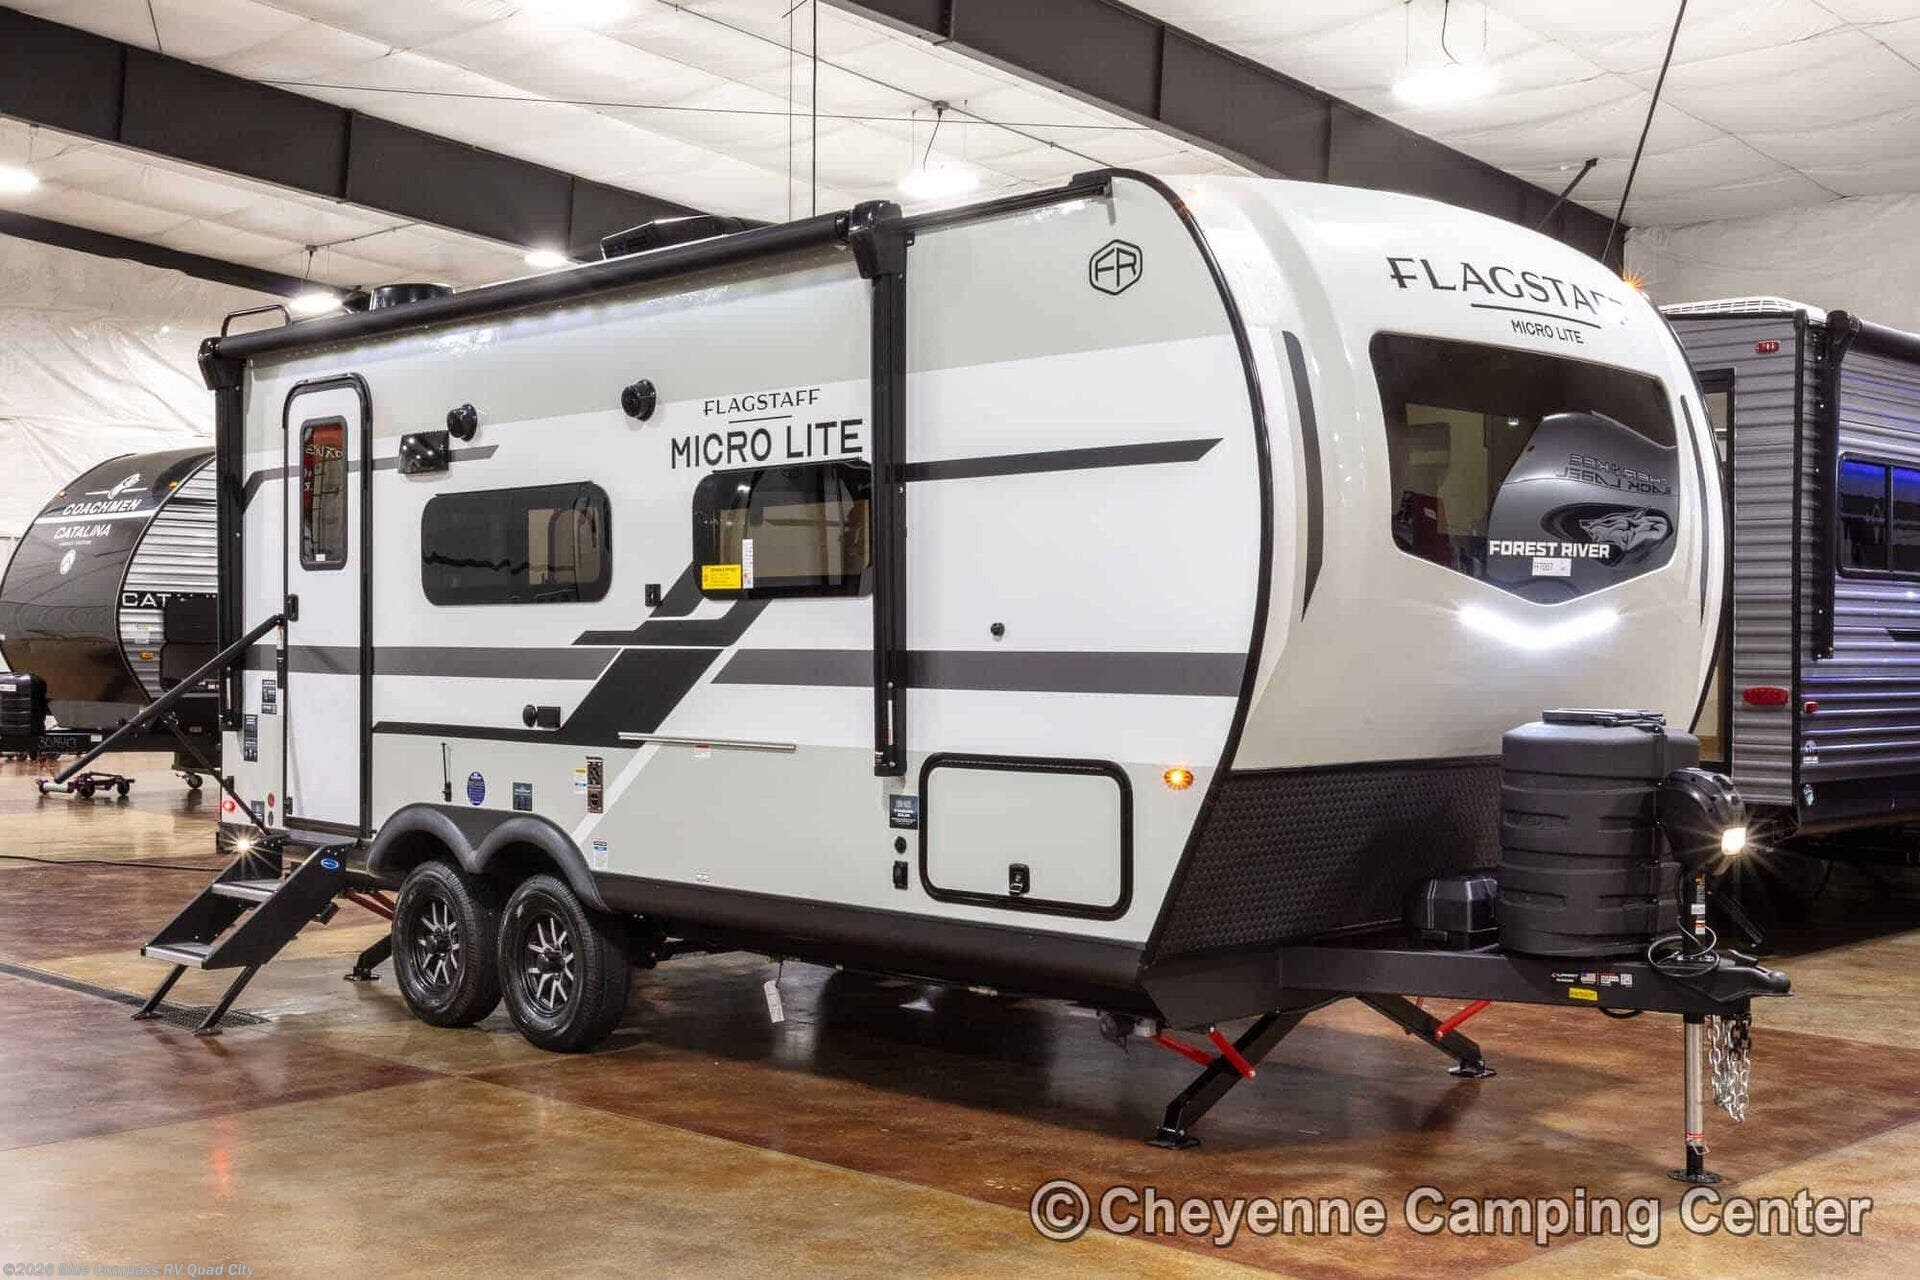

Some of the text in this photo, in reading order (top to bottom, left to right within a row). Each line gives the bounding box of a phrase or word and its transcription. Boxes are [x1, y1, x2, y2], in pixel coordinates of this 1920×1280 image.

[1386, 256, 1628, 325] FLAGSTA
[1510, 319, 1585, 344] MICRO LITE
[702, 388, 821, 416] FLAGSTAFF
[671, 418, 864, 470] MICRO LITE
[62, 498, 143, 516] COACHMEN
[54, 523, 112, 540] CATALINA
[1489, 540, 1611, 559] FOREST RIVER
[121, 592, 172, 608] CAT
